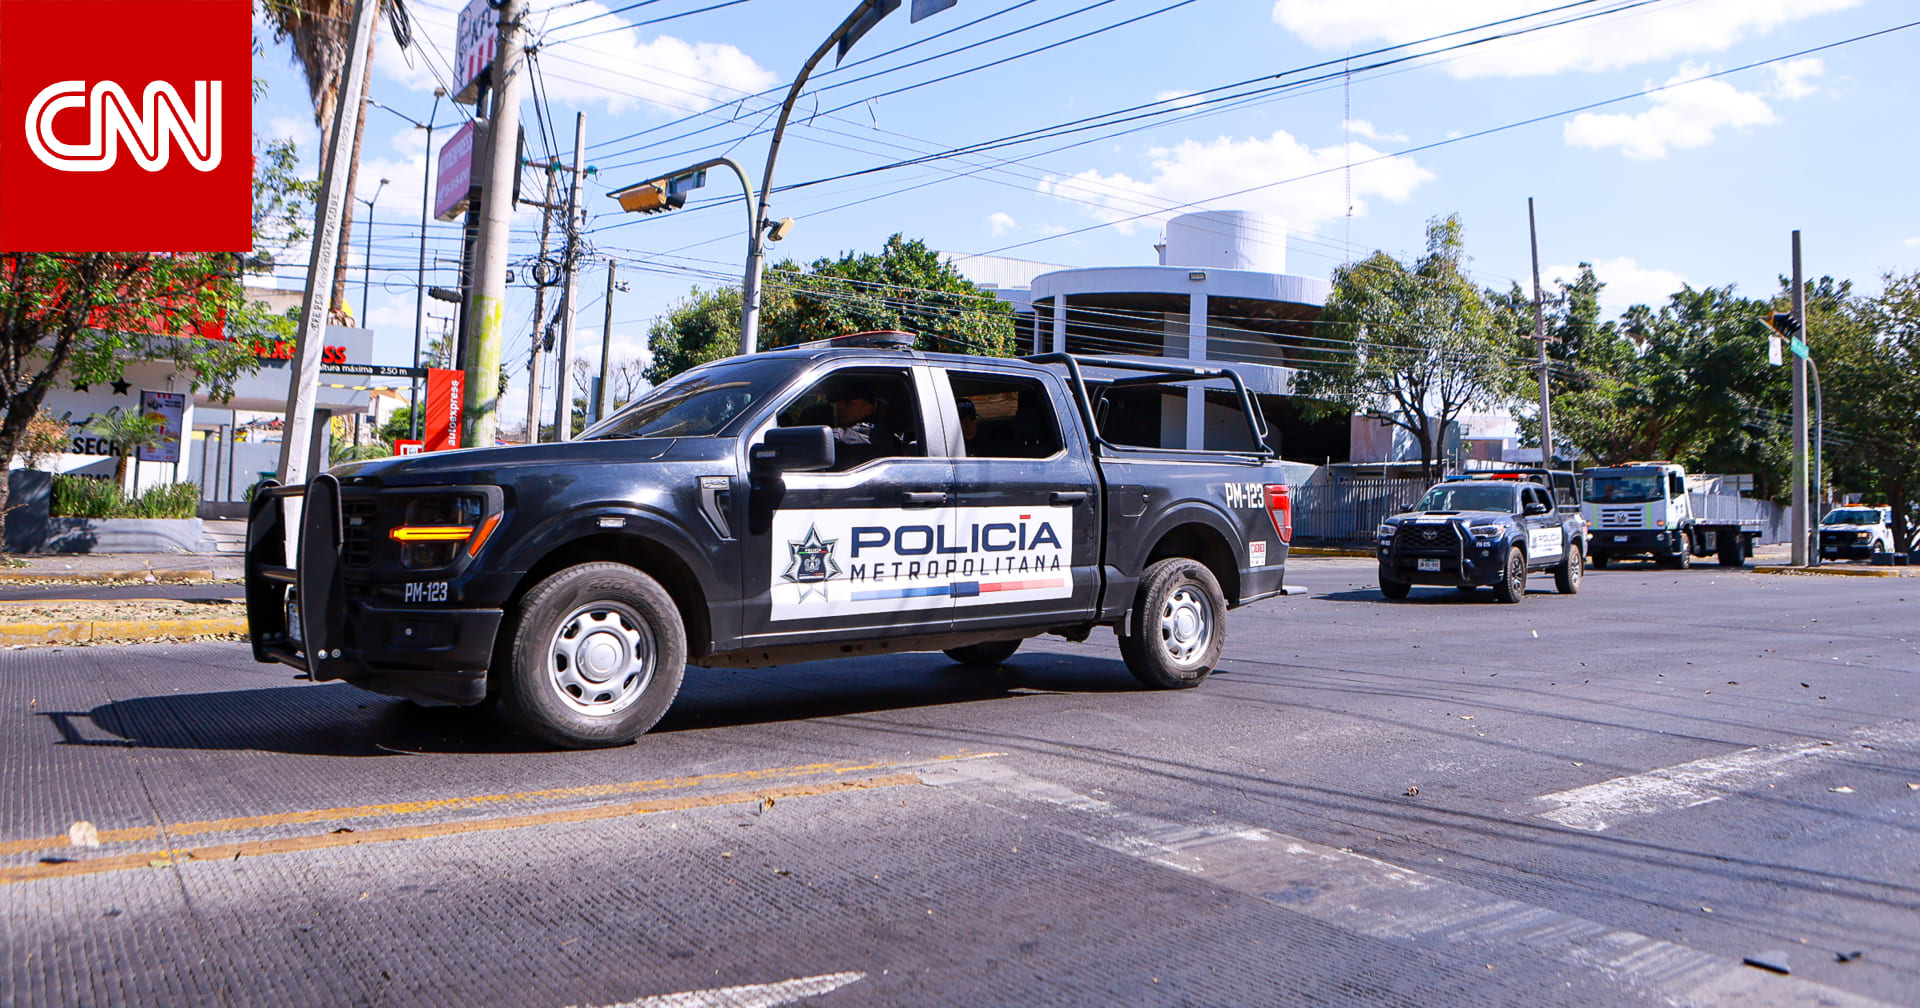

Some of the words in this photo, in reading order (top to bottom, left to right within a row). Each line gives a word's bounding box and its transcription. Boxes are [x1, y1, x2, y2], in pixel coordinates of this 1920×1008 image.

[342, 365, 373, 374] máxima
[381, 367, 398, 375] 2.50
[448, 380, 460, 447] autoexpress
[1224, 482, 1265, 509] PM-123
[850, 514, 1063, 558] POLICÍA
[850, 554, 1061, 583] METROPOLITANA
[404, 581, 449, 603] PM-123
